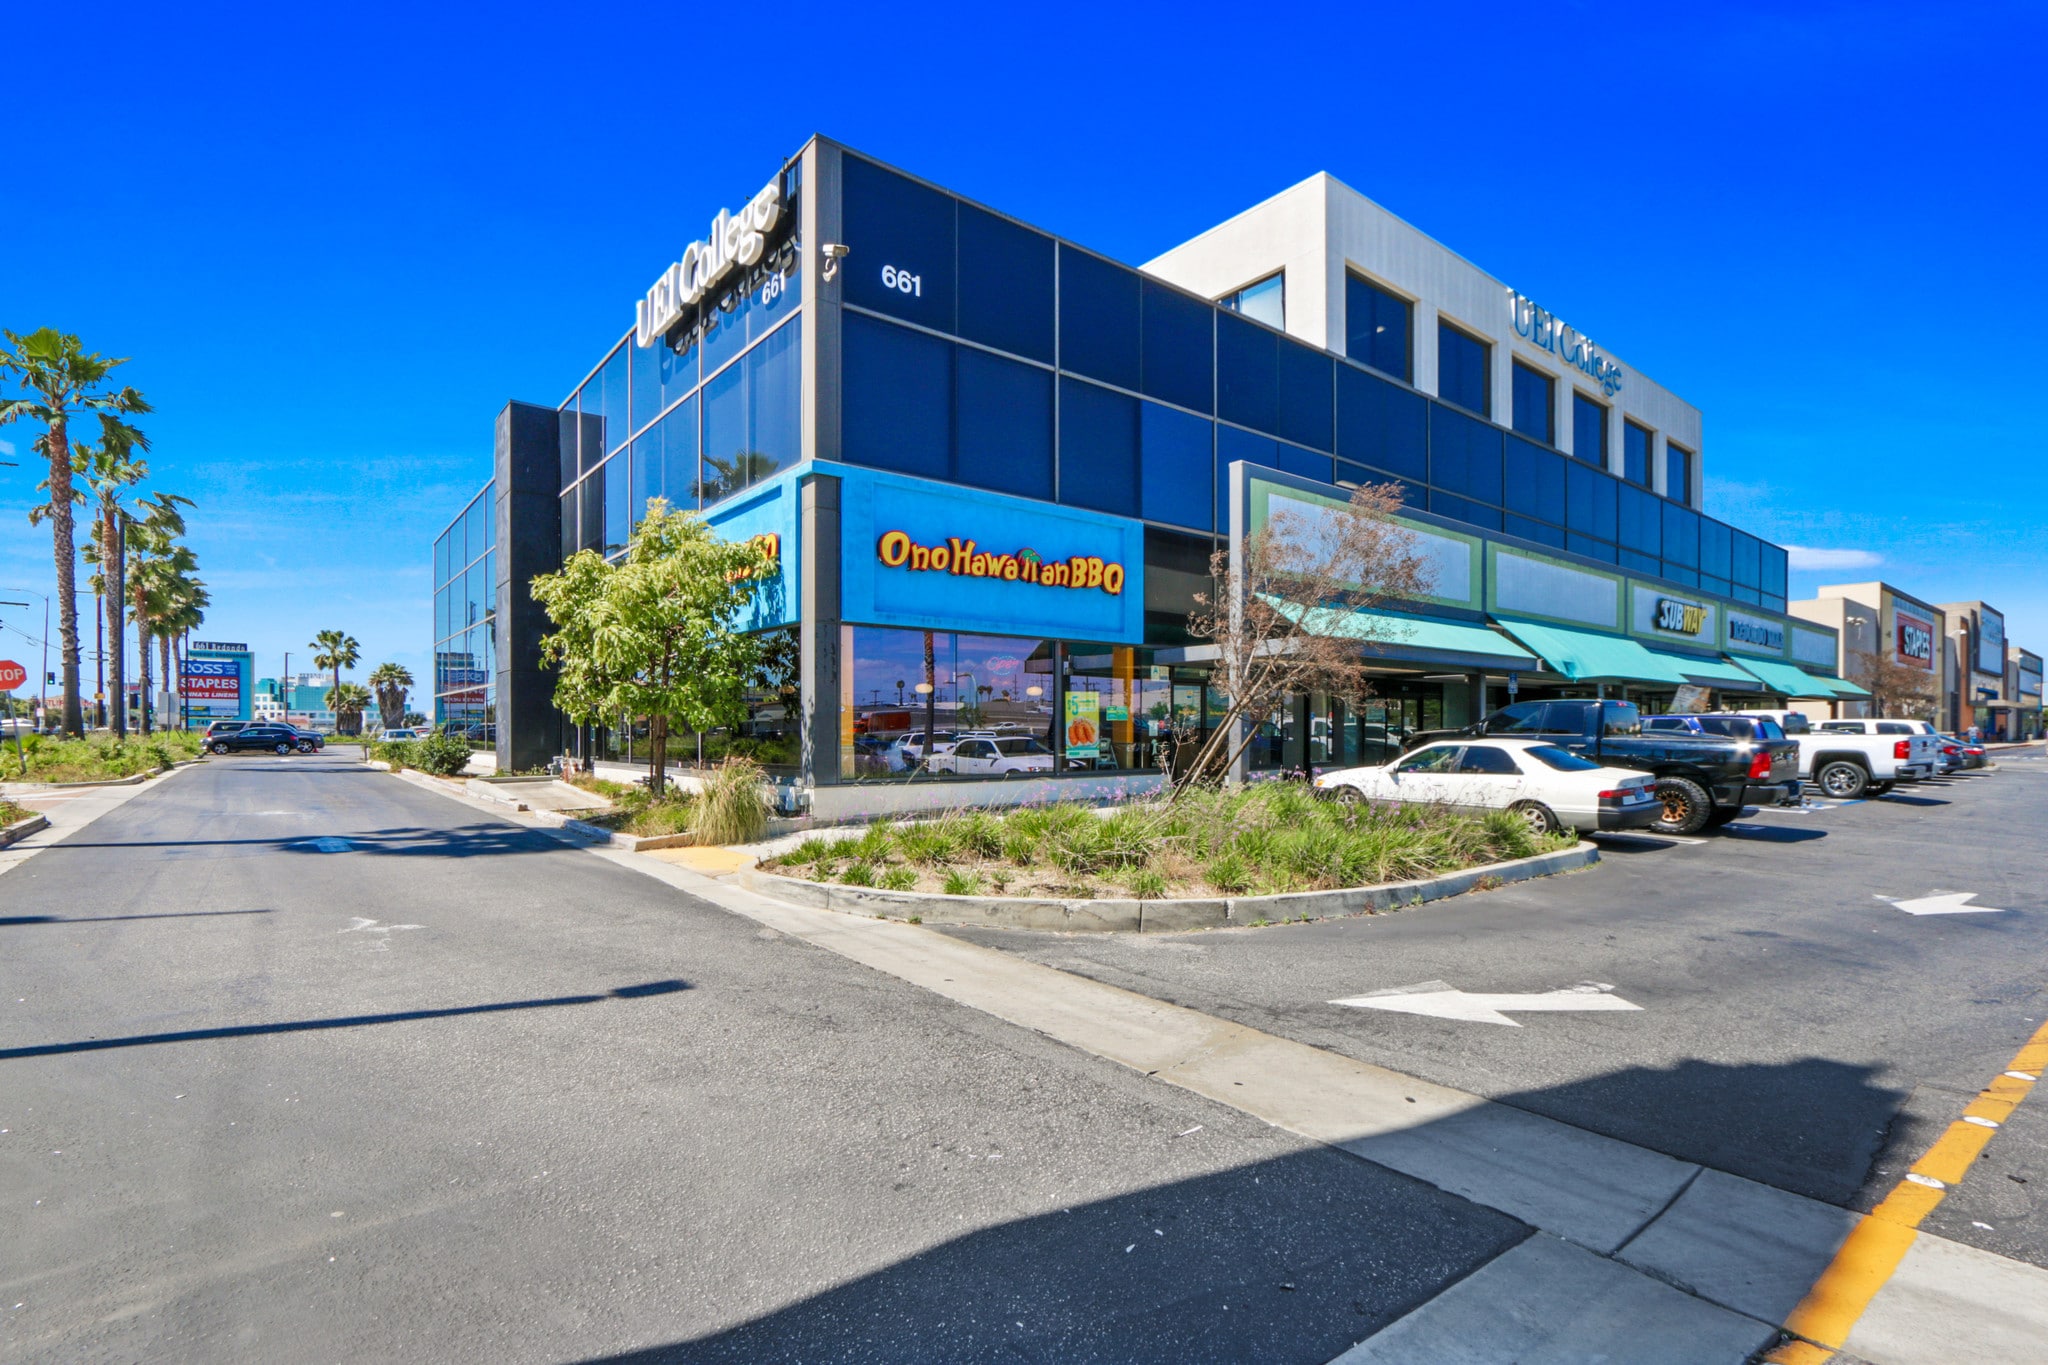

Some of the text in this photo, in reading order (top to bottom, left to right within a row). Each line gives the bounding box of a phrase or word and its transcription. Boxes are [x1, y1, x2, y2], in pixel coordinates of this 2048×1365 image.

[636, 183, 779, 348] UEI College
[881, 264, 921, 297] 661
[762, 268, 786, 305] 661
[1506, 286, 1622, 397] UEI College
[1658, 599, 1708, 635] SUBWAY
[1903, 624, 1931, 661] STAPLES
[0, 668, 24, 681] TOP
[180, 678, 239, 690] STAPLES
